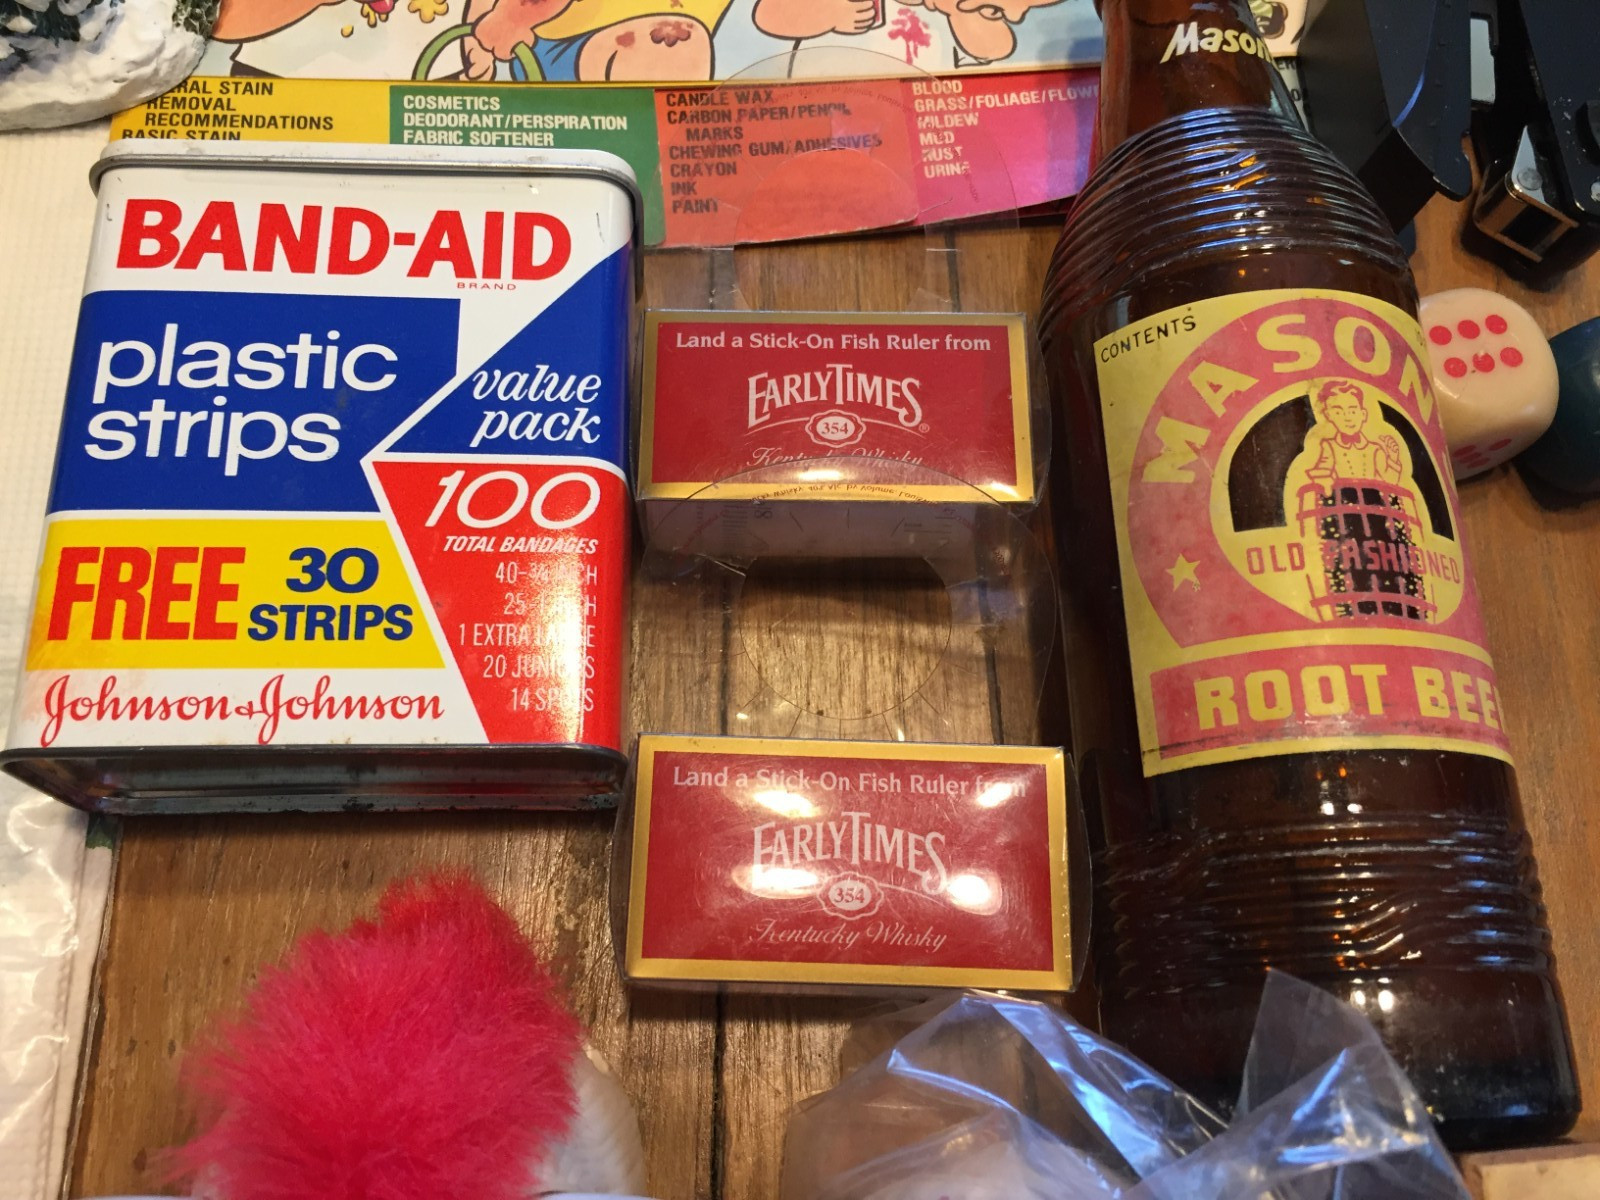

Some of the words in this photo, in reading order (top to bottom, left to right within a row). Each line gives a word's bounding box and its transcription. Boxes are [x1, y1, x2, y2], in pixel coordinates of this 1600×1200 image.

[219, 81, 274, 96] STAIN
[912, 79, 963, 96] BLOOD
[147, 97, 236, 112] REMOVAL
[403, 95, 501, 111] COSMETICS
[666, 91, 730, 107] CANDLE
[735, 89, 775, 104] WAX
[144, 113, 334, 130] RECOMMENDATIONS
[403, 113, 628, 130] DEODORANT/PERSPIRATION
[667, 109, 732, 125] CARBON
[917, 112, 980, 130] MILDEW
[186, 130, 241, 141] STAIN
[403, 130, 464, 145] FABRIC
[470, 131, 555, 147] SOFTENER
[686, 126, 744, 142] MARKS
[919, 131, 956, 147] MUD
[669, 143, 743, 160] CHEWING
[921, 146, 964, 163] RUST
[670, 161, 738, 178] CRAYON
[924, 161, 972, 179] URINE
[670, 181, 697, 196] INK
[672, 198, 719, 214] PAINT
[116, 198, 572, 281] BAND-AID
[456, 282, 517, 291] BRAND
[676, 332, 725, 349] Land
[731, 337, 743, 349] a
[750, 332, 835, 350] Stick-On
[841, 333, 880, 350] Fish
[886, 333, 940, 351] Ruler
[944, 333, 991, 352] from
[1100, 314, 1198, 363] CONTENTS
[92, 323, 399, 405] plastic
[471, 364, 602, 402] value
[84, 395, 341, 477] strips
[470, 407, 602, 448] pack
[821, 420, 850, 437] 354
[424, 470, 601, 530] 100
[442, 535, 496, 552] TOTAL
[499, 536, 599, 555] BANDAGES
[1246, 543, 1305, 575] OLD
[47, 546, 247, 641] FREE
[286, 547, 380, 593] 30
[247, 603, 414, 642] STRIPS
[459, 623, 467, 646] 1
[473, 624, 530, 647] EXTRA
[535, 624, 596, 648] LAE
[483, 655, 507, 678] 20
[512, 655, 596, 680] JUNIOS
[511, 688, 529, 711] 14
[1193, 664, 1387, 730] ROOT
[1412, 666, 1505, 734] BEE
[39, 675, 229, 748] Johnson
[256, 674, 446, 745] Johnson
[673, 766, 728, 788] Land
[736, 772, 748, 789] a
[756, 769, 851, 792] Stick-On
[859, 772, 901, 793] Fish
[910, 775, 969, 796] Ruler
[976, 775, 1026, 798] frm
[833, 887, 865, 905] 354
[749, 918, 860, 950] Kentucky
[867, 920, 947, 953] Whisky
